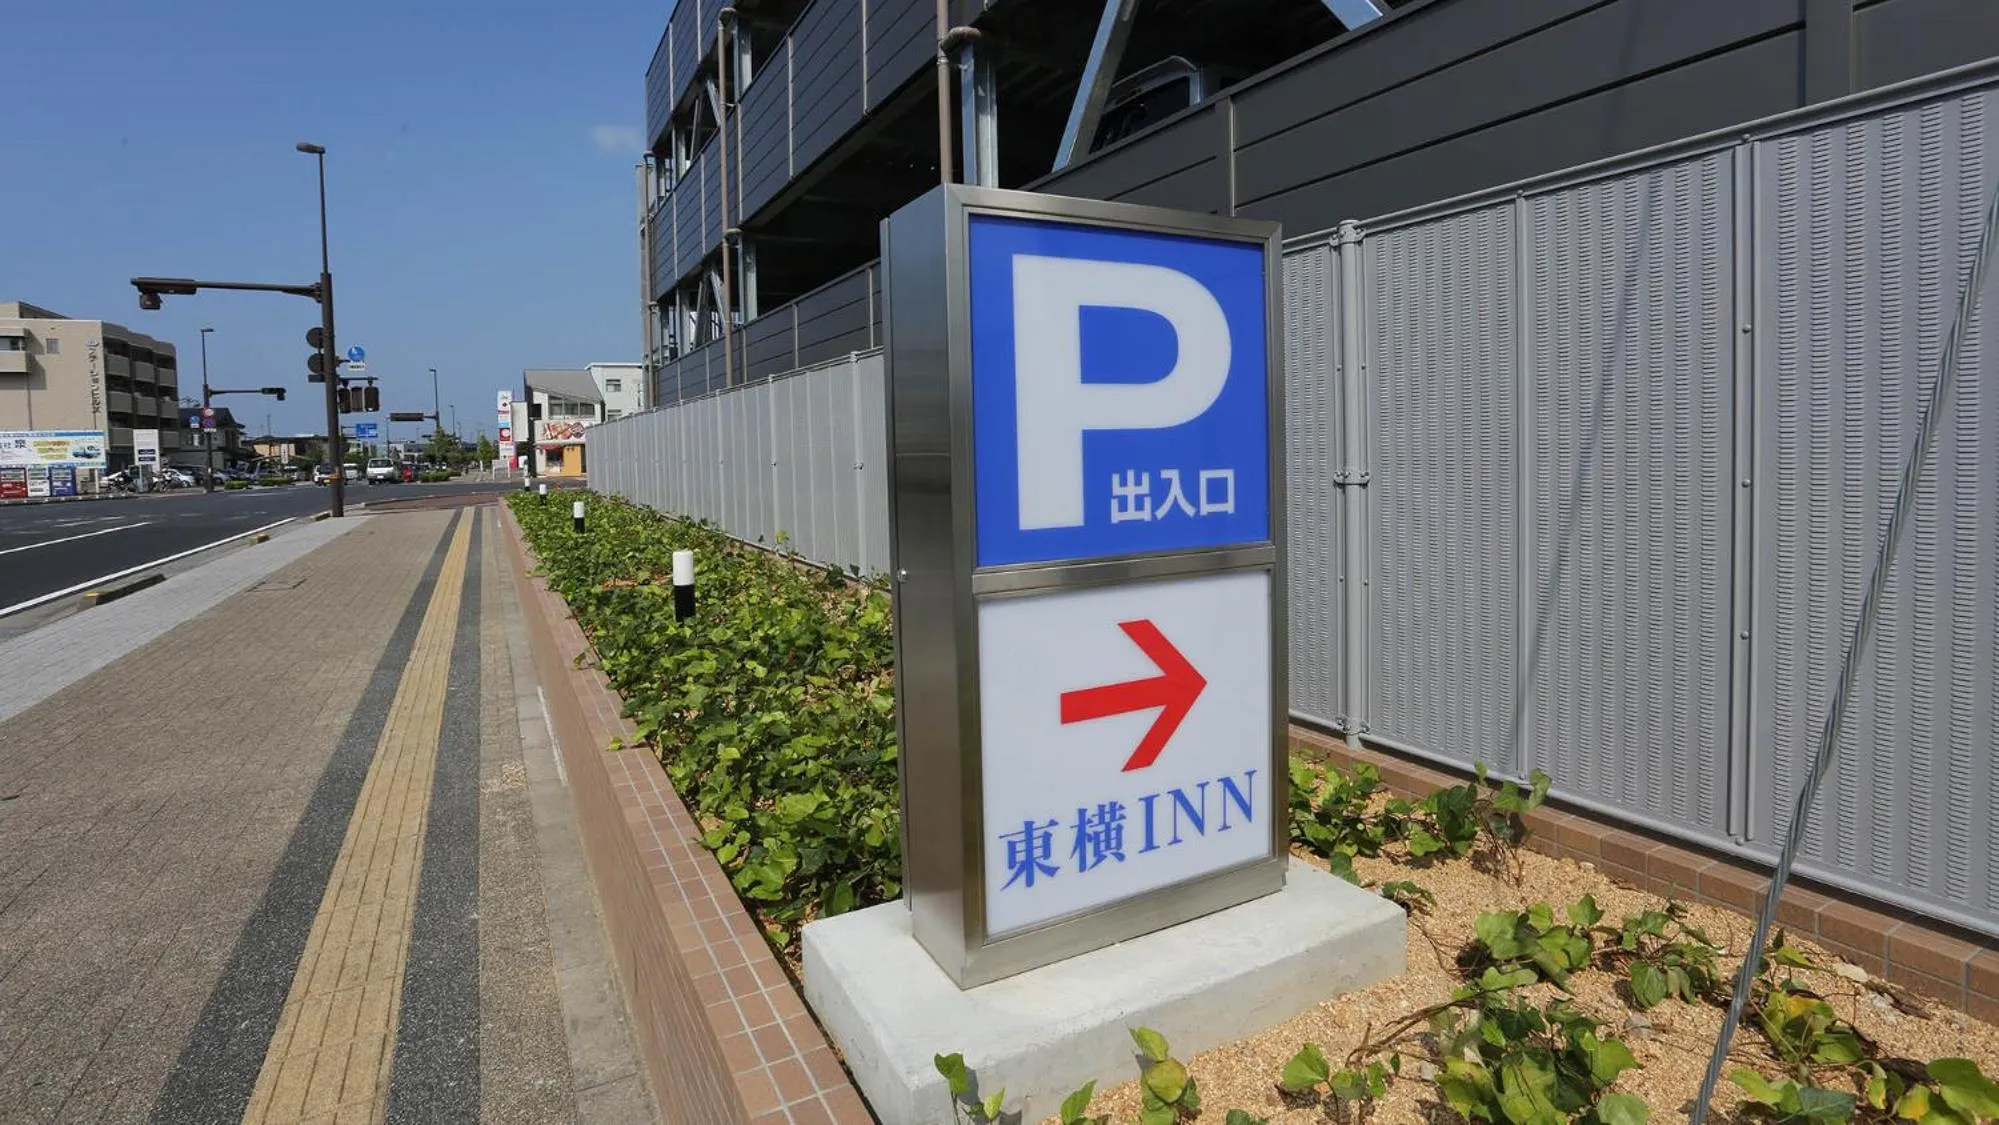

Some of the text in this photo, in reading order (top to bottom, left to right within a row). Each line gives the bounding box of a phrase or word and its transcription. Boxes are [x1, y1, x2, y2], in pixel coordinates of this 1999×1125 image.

[1012, 253, 1232, 531] P
[1110, 468, 1235, 525] 出入口
[998, 769, 1258, 892] 東横INN
